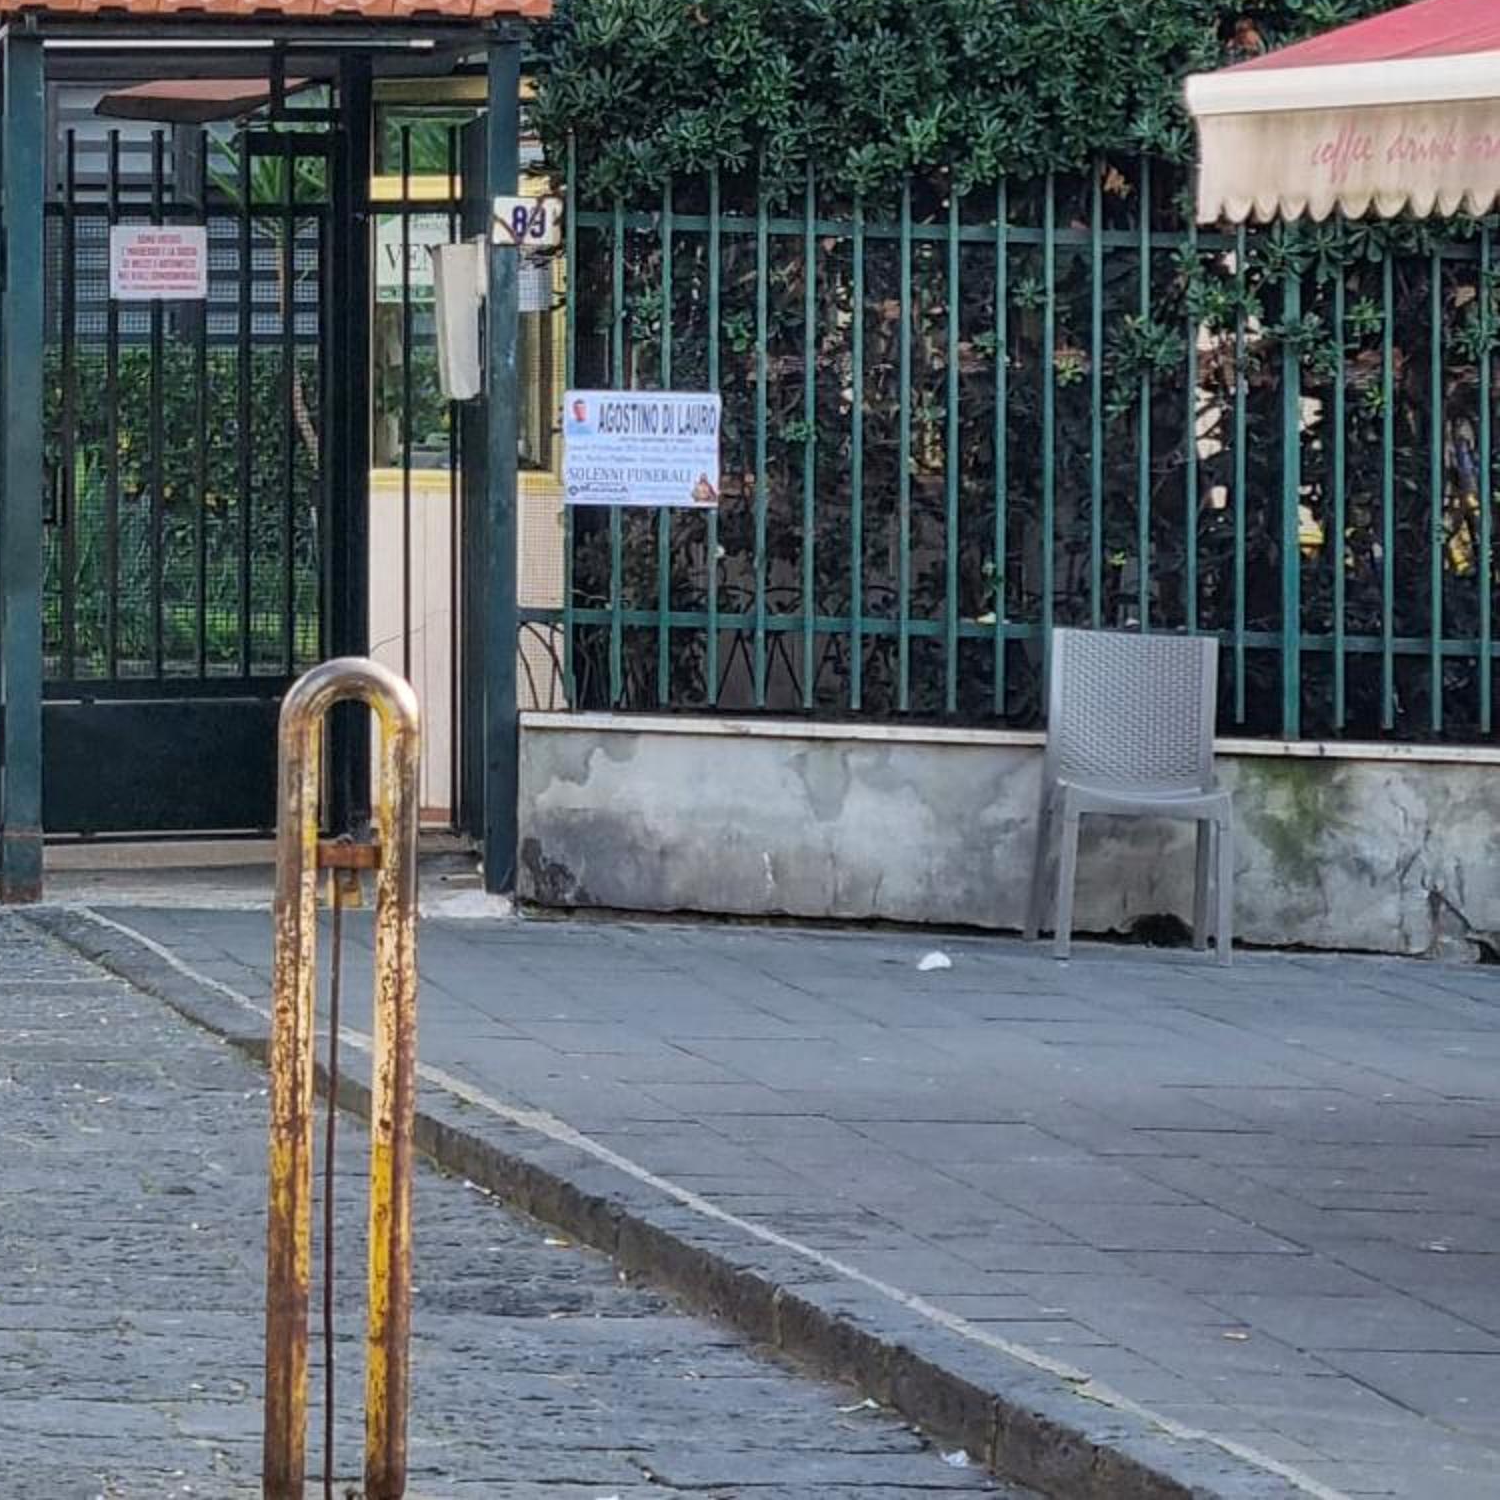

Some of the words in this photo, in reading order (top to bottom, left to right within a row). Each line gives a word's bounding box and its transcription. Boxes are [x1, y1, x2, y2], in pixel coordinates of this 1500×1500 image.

[1311, 116, 1374, 184] coffee
[512, 205, 547, 238] 89
[597, 403, 659, 435] AGOSTINO
[662, 404, 675, 435] DI
[678, 404, 717, 436] LAURO
[568, 467, 624, 481] SOLENNI
[628, 467, 692, 483] FUNERALI
